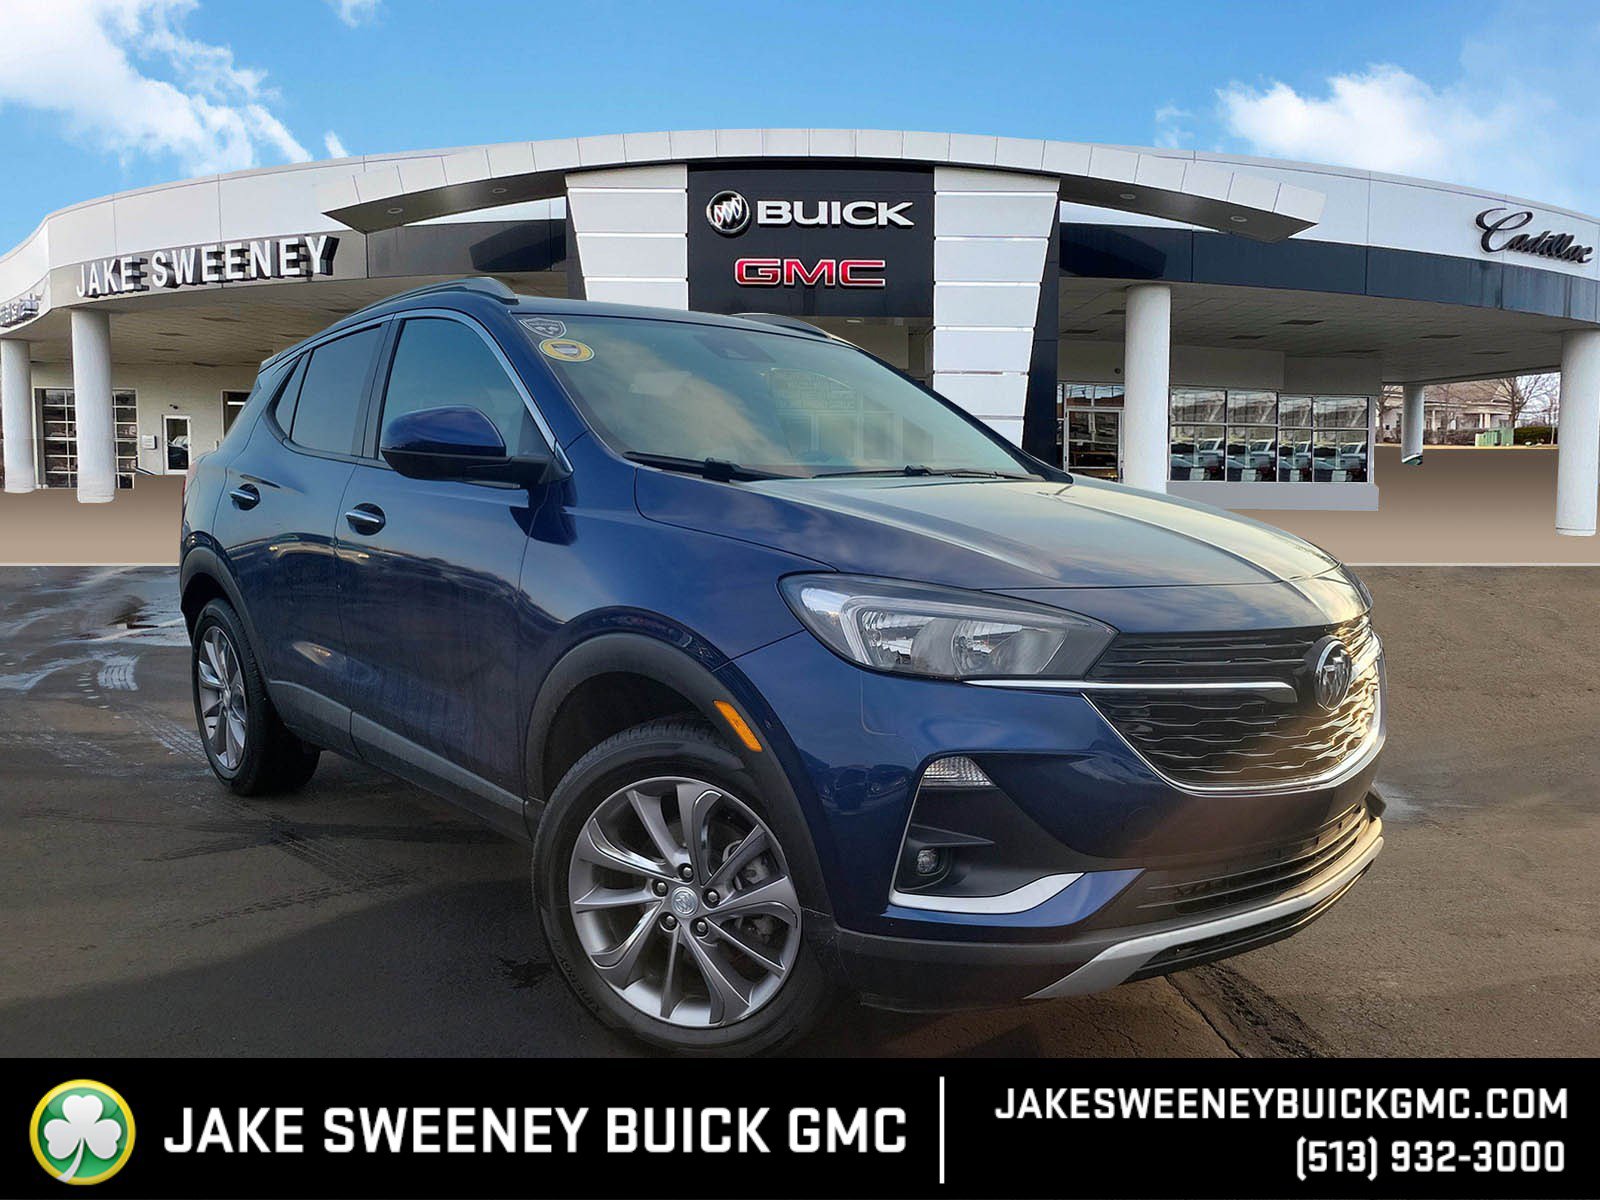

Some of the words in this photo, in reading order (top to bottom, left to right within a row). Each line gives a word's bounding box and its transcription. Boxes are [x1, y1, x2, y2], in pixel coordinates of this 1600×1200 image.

[757, 200, 914, 227] BUICK
[1475, 208, 1593, 264] Cadillac
[76, 256, 144, 298] JAKE
[152, 235, 336, 288] SWEENEY
[735, 258, 887, 288] GMC
